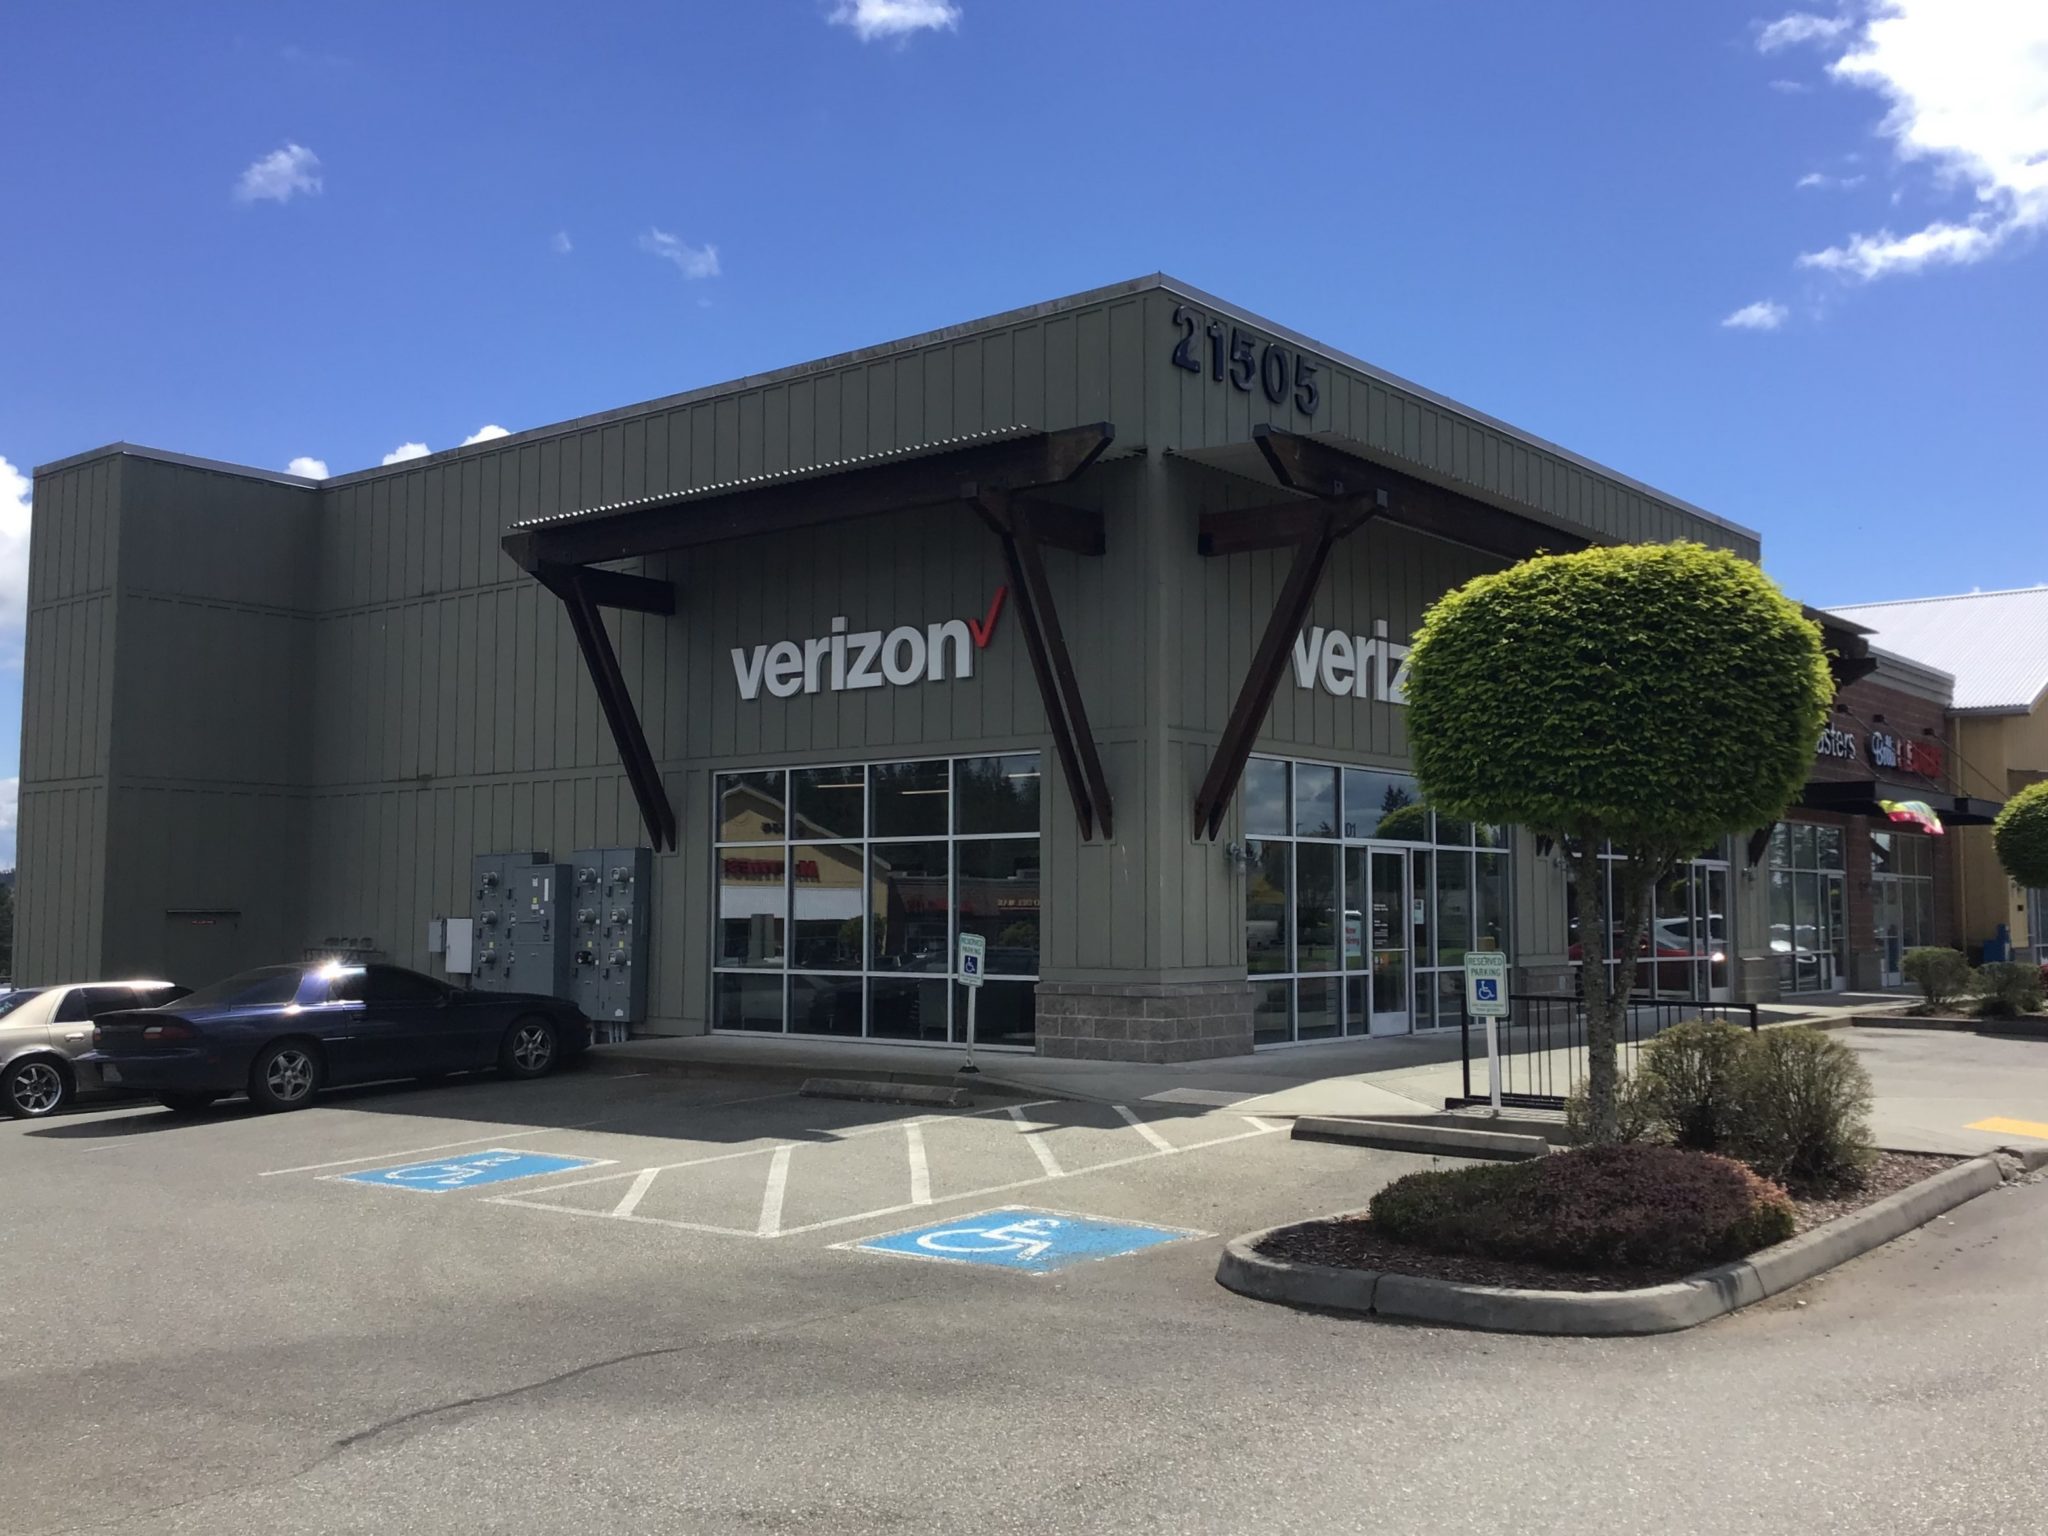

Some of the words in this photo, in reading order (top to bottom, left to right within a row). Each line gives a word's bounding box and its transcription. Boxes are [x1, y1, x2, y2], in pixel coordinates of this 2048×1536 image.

[1172, 304, 1319, 415] 21505
[730, 616, 974, 699] verizon
[1291, 619, 1412, 705] veriz
[1467, 957, 1504, 966] RESERVED
[1471, 968, 1502, 976] PARKING
